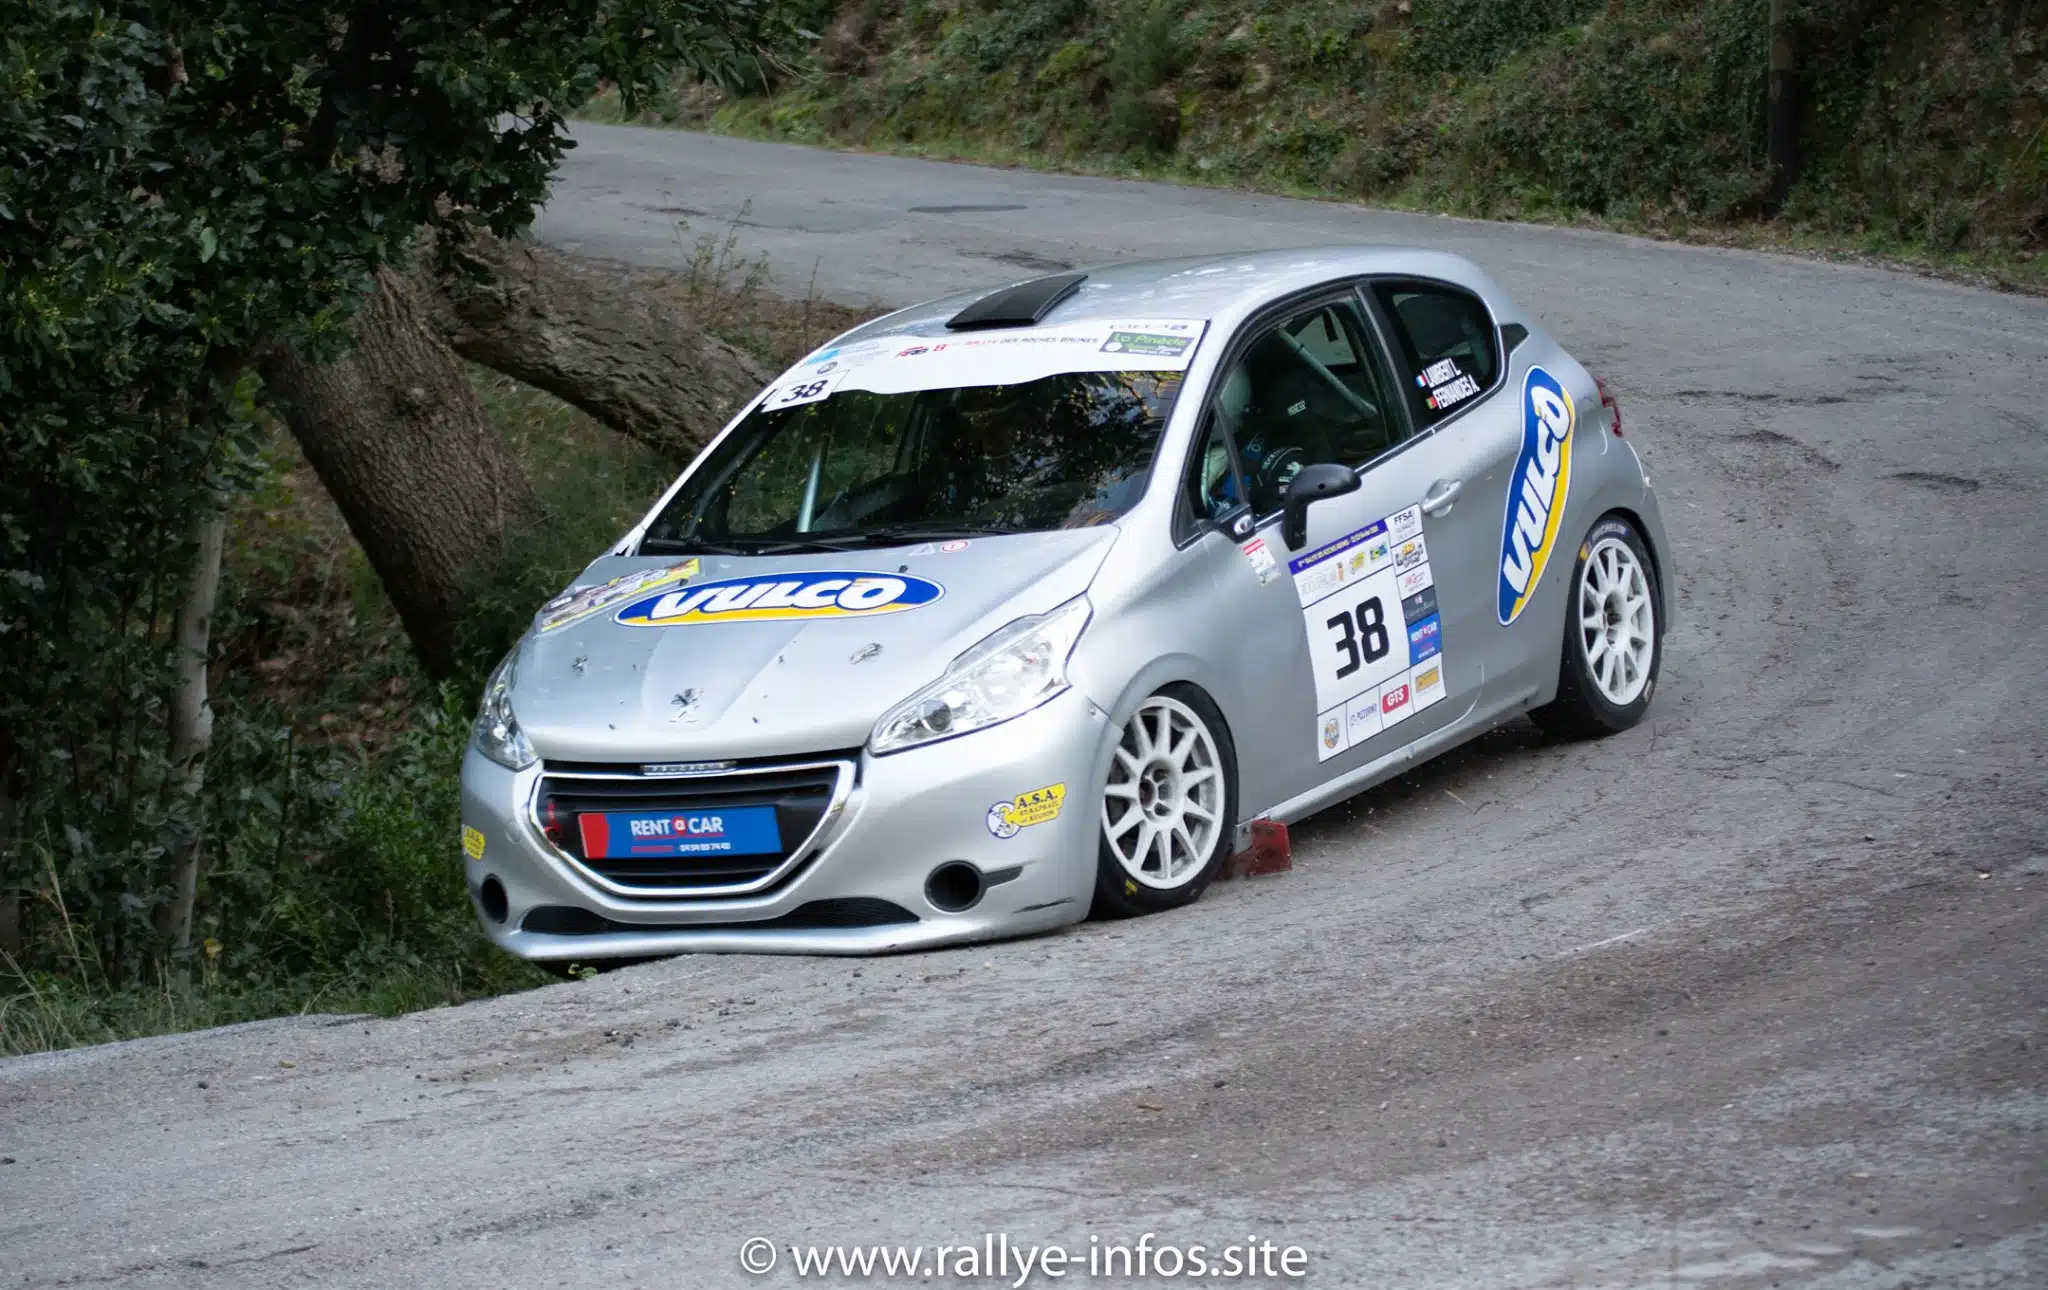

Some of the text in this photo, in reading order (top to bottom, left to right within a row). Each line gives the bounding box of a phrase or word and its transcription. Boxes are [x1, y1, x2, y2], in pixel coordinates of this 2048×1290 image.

[781, 380, 828, 402] 38
[1503, 386, 1570, 595] VULCO
[1394, 510, 1414, 524] FFSA
[647, 577, 906, 620] VULCO
[1326, 596, 1390, 680] 38
[1387, 687, 1405, 707] GTS
[1017, 789, 1059, 808] A.S.A.
[630, 819, 671, 836] RENT
[688, 816, 724, 834] CAR
